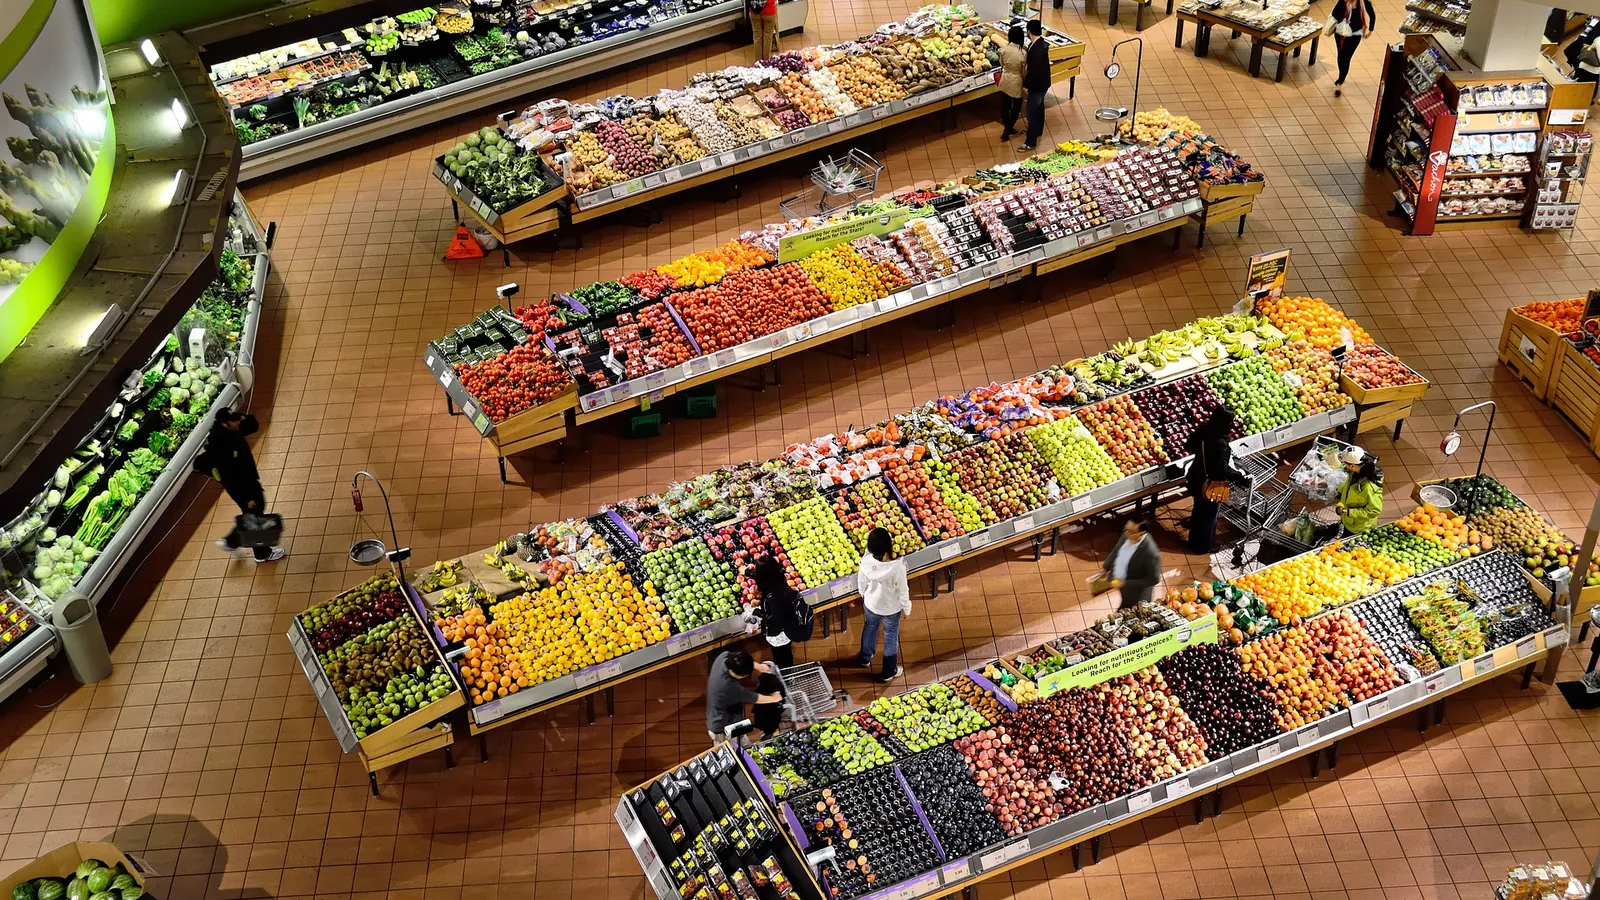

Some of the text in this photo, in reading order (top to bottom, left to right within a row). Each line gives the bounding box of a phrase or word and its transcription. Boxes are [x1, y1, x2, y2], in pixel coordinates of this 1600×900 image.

[1428, 151, 1447, 201] Vachon
[802, 233, 822, 241] Looking
[831, 224, 855, 232] nutritious
[856, 218, 877, 227] choices?
[816, 234, 831, 242] Reach
[1071, 664, 1098, 677] Looking
[1099, 659, 1109, 667] for
[1110, 647, 1143, 662] nutritious
[1145, 635, 1173, 649] choices?
[1090, 666, 1111, 677] Reach
[1112, 661, 1121, 669] for
[1123, 656, 1135, 665] the
[1136, 647, 1156, 660] Stars!
